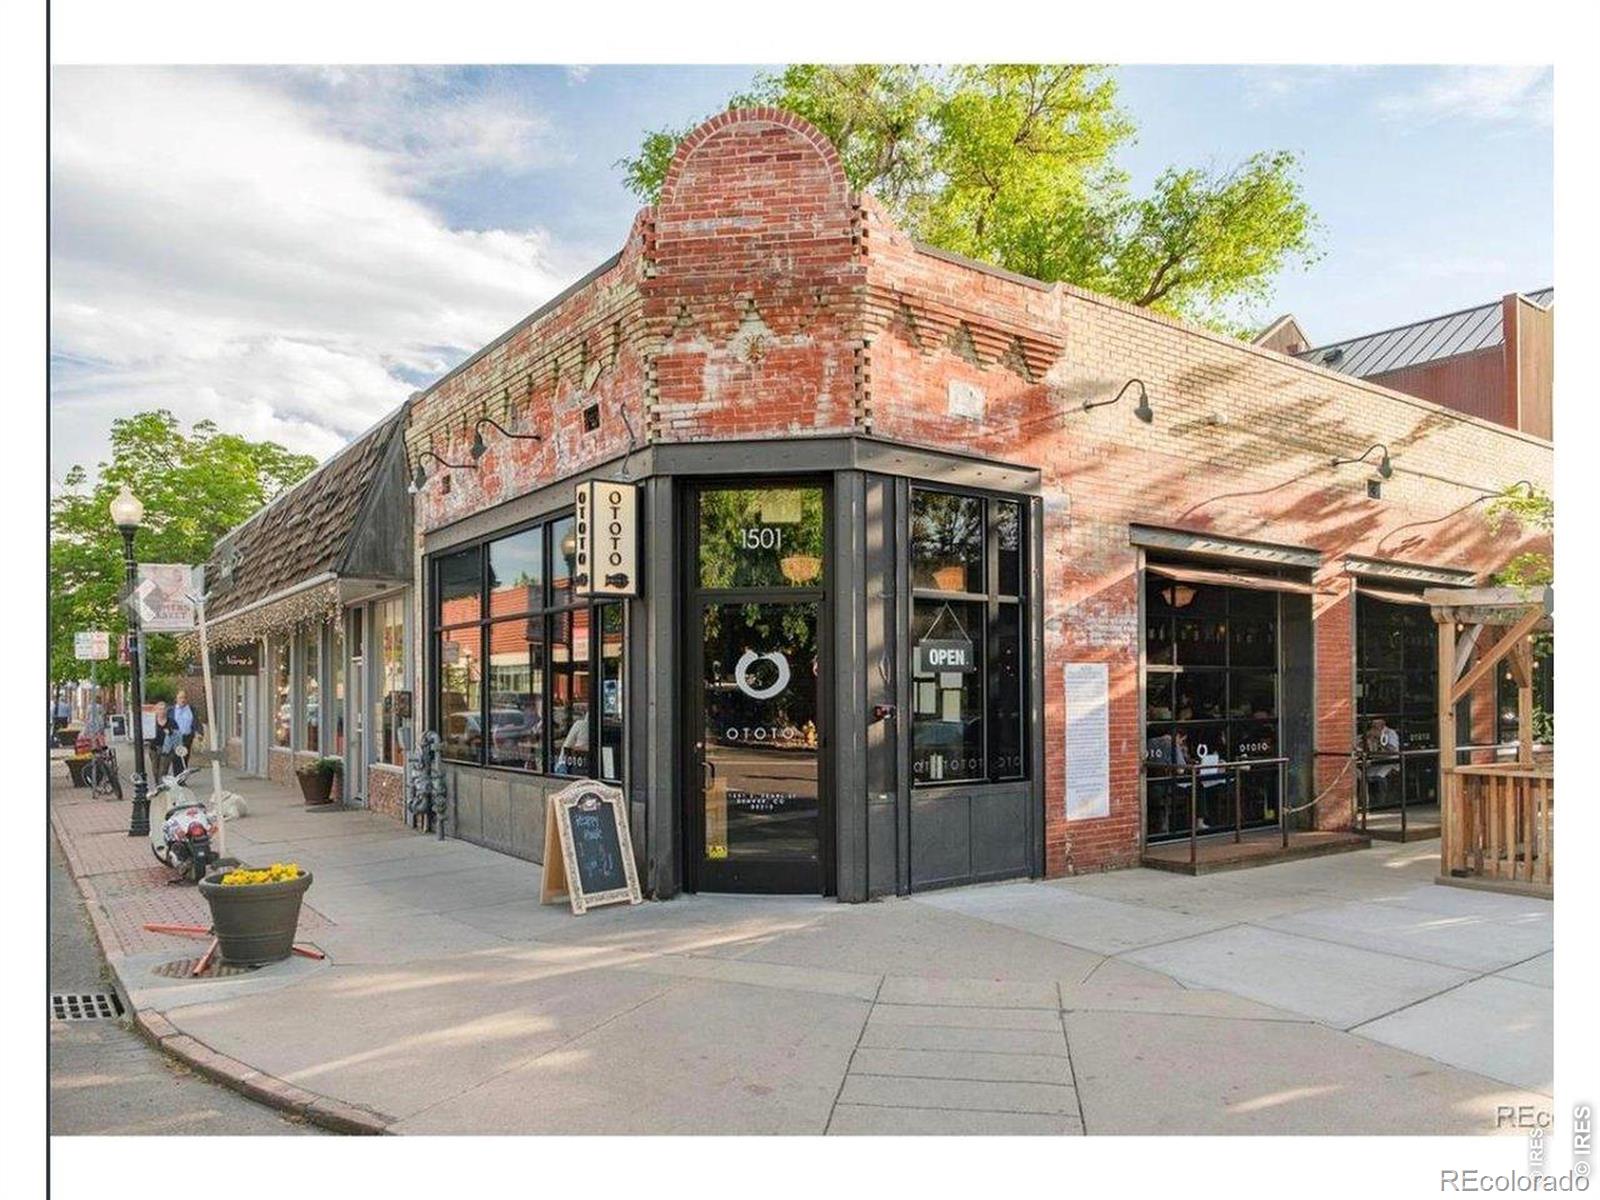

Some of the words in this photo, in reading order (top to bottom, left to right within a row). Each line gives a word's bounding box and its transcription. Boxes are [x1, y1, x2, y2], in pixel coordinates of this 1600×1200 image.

[578, 491, 587, 565] OTOTO
[609, 491, 621, 566] OTOTO
[740, 527, 782, 550] 1501
[929, 648, 965, 666] OPEN
[726, 727, 795, 740] OTOTO
[1239, 742, 1269, 752] OTOTO
